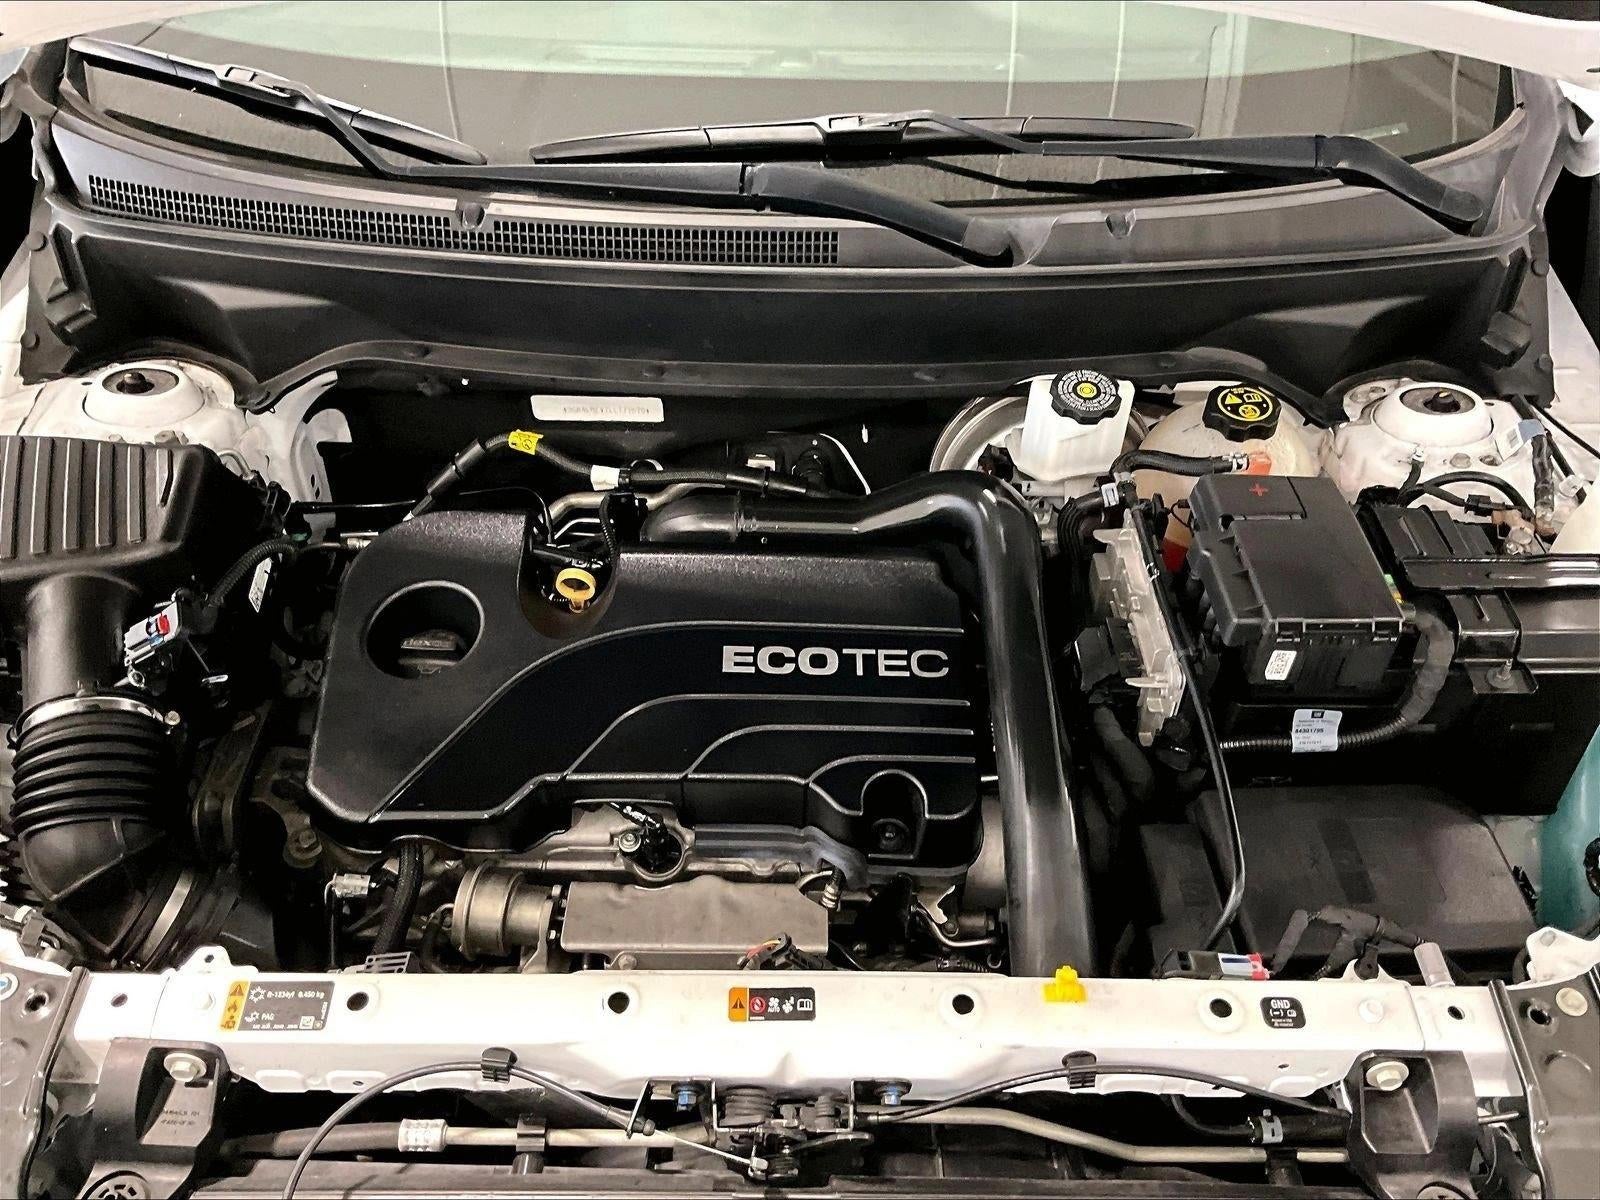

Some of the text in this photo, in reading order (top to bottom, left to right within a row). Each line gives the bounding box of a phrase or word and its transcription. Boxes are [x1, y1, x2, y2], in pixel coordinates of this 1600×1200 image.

[721, 645, 950, 679] ECOTEC
[316, 991, 325, 999] kg
[1270, 999, 1291, 1009] GND
[261, 1012, 275, 1021] PAG
